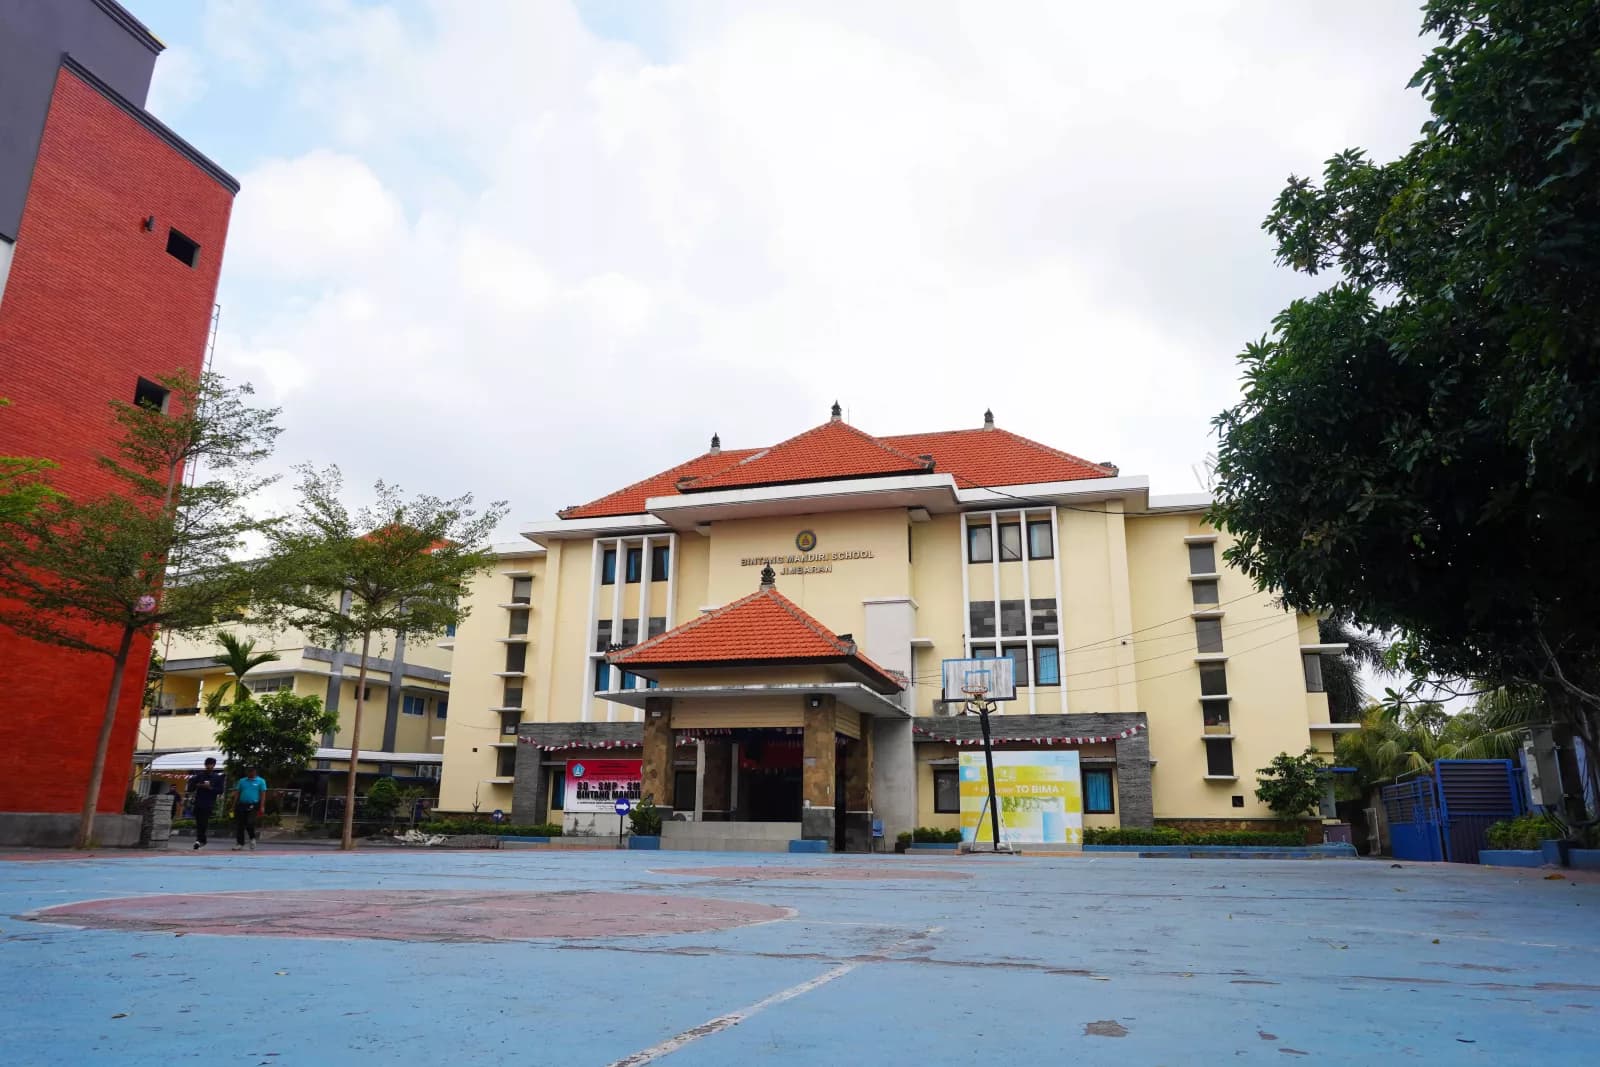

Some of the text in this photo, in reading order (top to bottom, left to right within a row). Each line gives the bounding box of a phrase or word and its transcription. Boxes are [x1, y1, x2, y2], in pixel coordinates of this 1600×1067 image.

[741, 556, 785, 567] BINTANG
[831, 550, 874, 561] SCHOOL
[780, 565, 833, 576] JIMBARAN
[577, 781, 589, 790] SD
[598, 781, 618, 790] SMP
[1016, 784, 1030, 793] TO
[1031, 784, 1060, 793] BIMA
[576, 790, 610, 800] BINTANG
